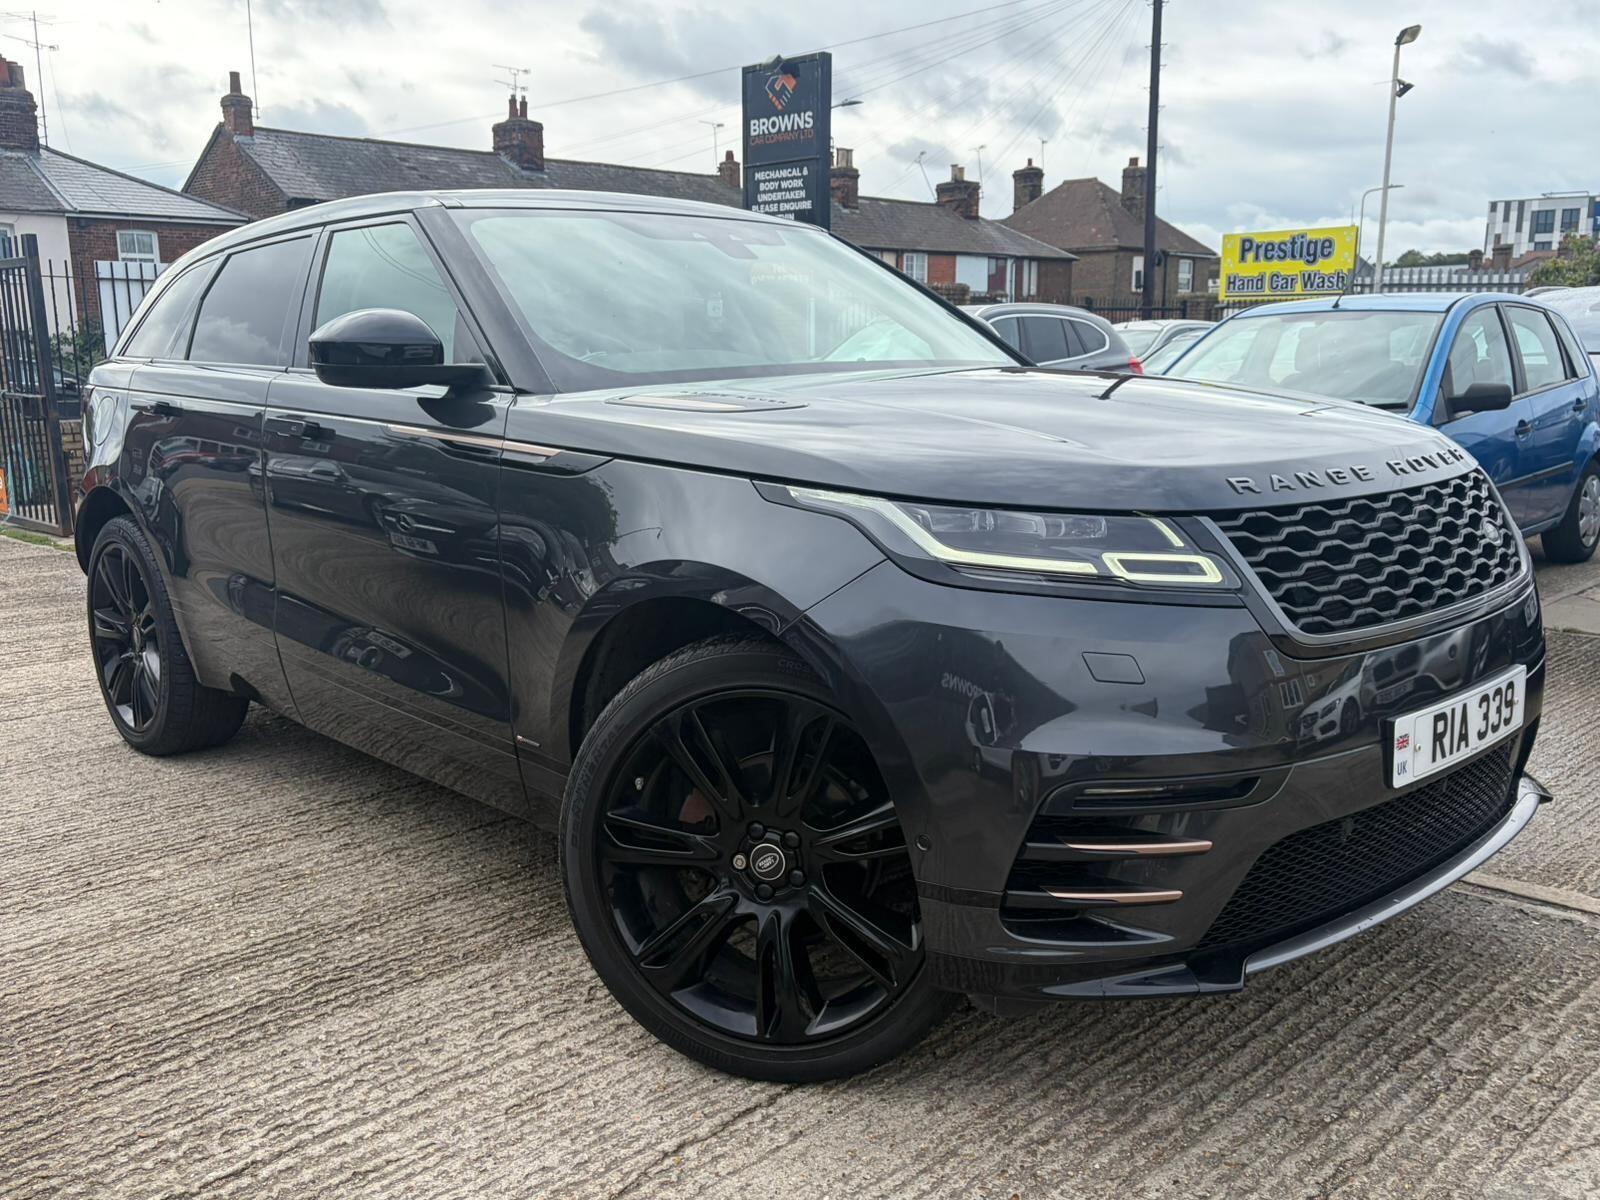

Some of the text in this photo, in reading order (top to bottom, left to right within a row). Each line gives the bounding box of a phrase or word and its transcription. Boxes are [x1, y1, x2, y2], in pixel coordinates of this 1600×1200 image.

[750, 111, 813, 137] BROWNS
[750, 128, 814, 146] CAR COMPANY LTD
[754, 166, 808, 181] MECHANICAL &
[759, 178, 803, 191] BODY WORK
[757, 189, 806, 202] UNDERTAKEN
[752, 200, 813, 213] PLEASE ENQUIRE
[1239, 232, 1335, 266] Prestige
[1226, 269, 1348, 293] Hand Car Wash
[1226, 448, 1465, 495] RANGE ROVER
[1432, 680, 1515, 763] RIA 339
[1397, 759, 1408, 776] UK
